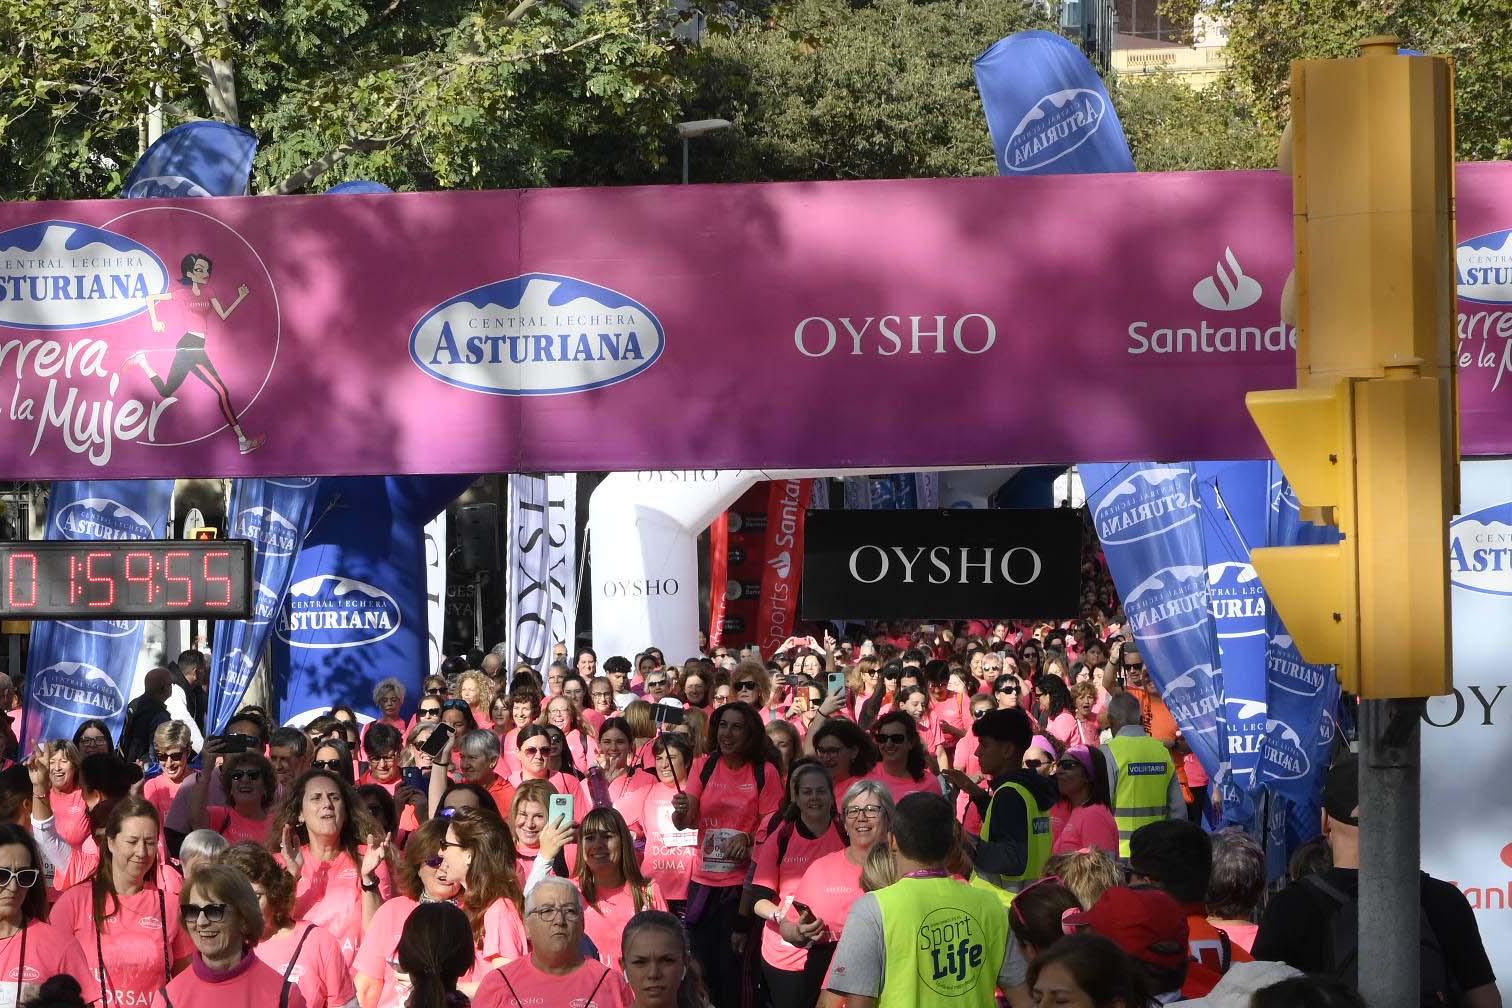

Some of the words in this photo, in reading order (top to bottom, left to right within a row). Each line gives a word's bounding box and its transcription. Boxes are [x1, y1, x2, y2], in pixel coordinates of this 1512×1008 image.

[72, 257, 144, 269] LECHERA
[468, 314, 548, 328] CENTRAL
[555, 313, 636, 326] LECHERA
[794, 313, 997, 358] OYSHO
[428, 323, 645, 365] ASTURIANA
[10, 381, 35, 421] la
[29, 372, 179, 467] Mujer
[848, 544, 1043, 587] OYSHO
[291, 600, 333, 608] CENTRAL
[338, 599, 387, 607] LECHERA
[602, 577, 679, 599] OYSHO
[278, 609, 392, 631] ASTURIANA
[37, 677, 116, 712] ASTURIANA
[652, 859, 685, 871] SUMA
[920, 915, 973, 951] Sport
[931, 938, 983, 981] Life
